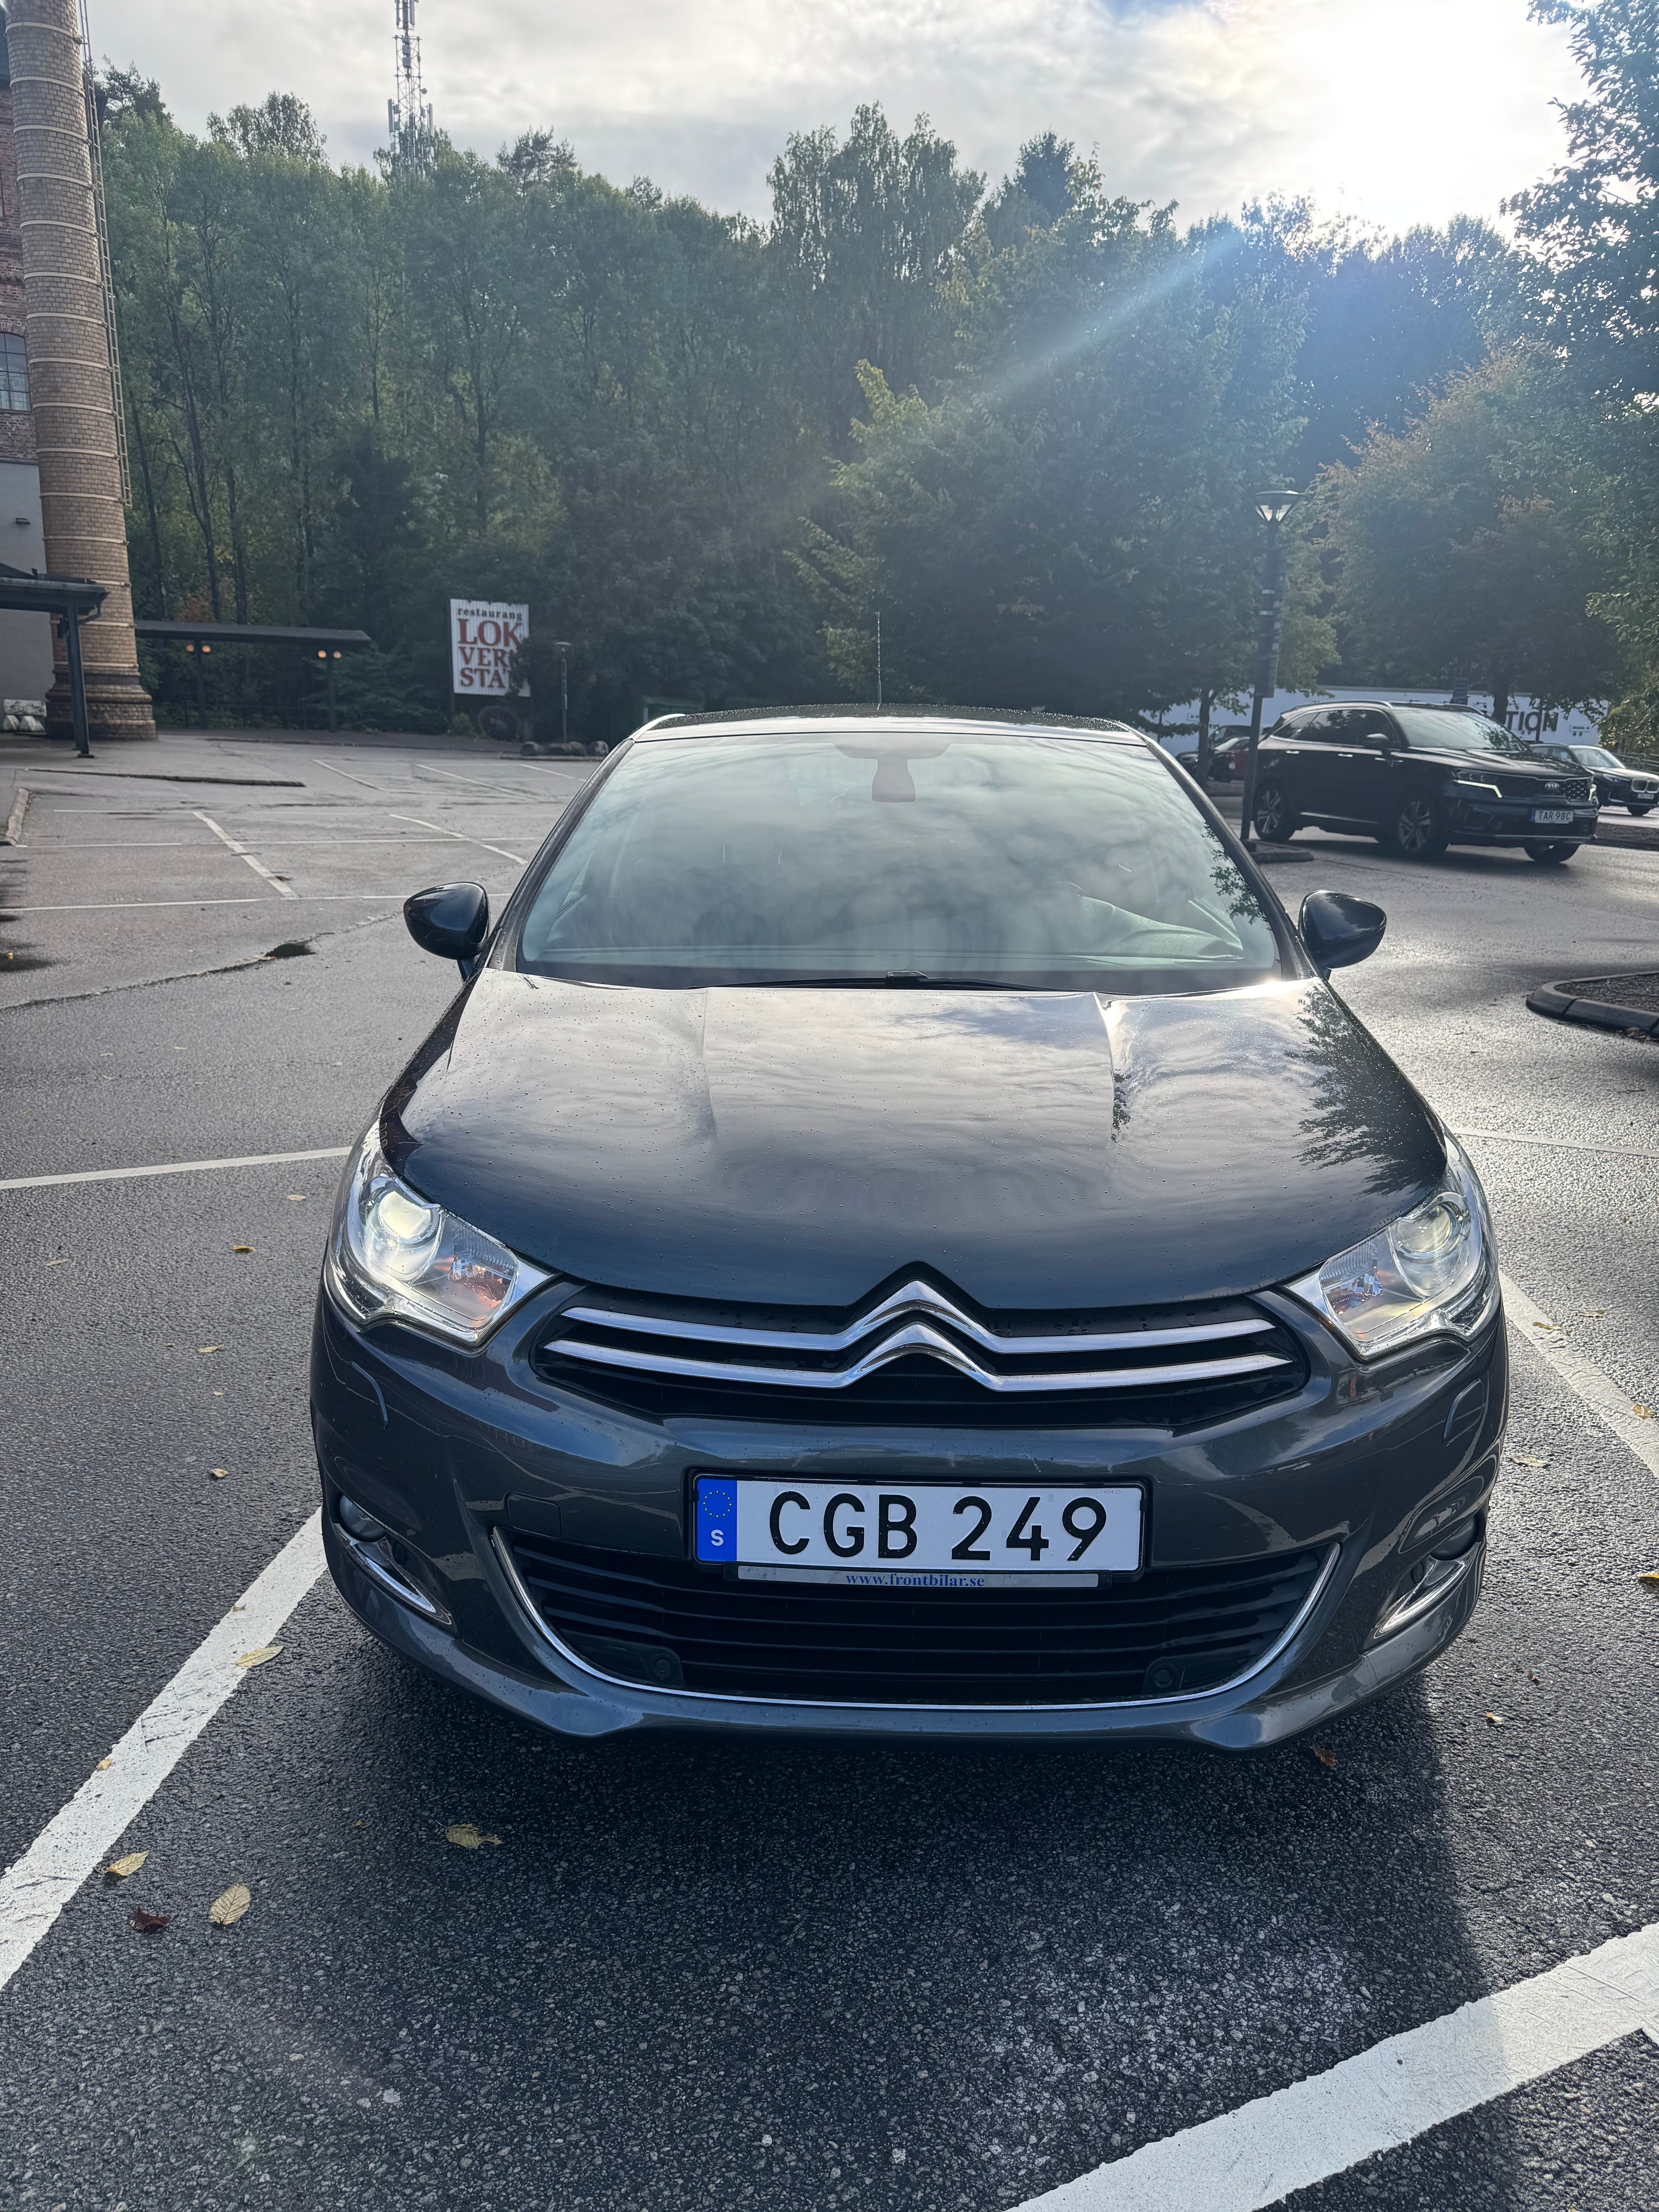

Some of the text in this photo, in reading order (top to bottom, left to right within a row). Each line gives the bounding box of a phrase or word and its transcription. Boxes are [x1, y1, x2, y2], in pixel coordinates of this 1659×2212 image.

[458, 607, 522, 622] restaurang
[457, 618, 522, 648] LOK
[1506, 711, 1559, 732] TION
[1539, 811, 1570, 820] TAR 98C
[769, 1491, 1107, 1561] CGB 249
[711, 1529, 724, 1546] S
[845, 1573, 985, 1587] www.frontbilar.se
